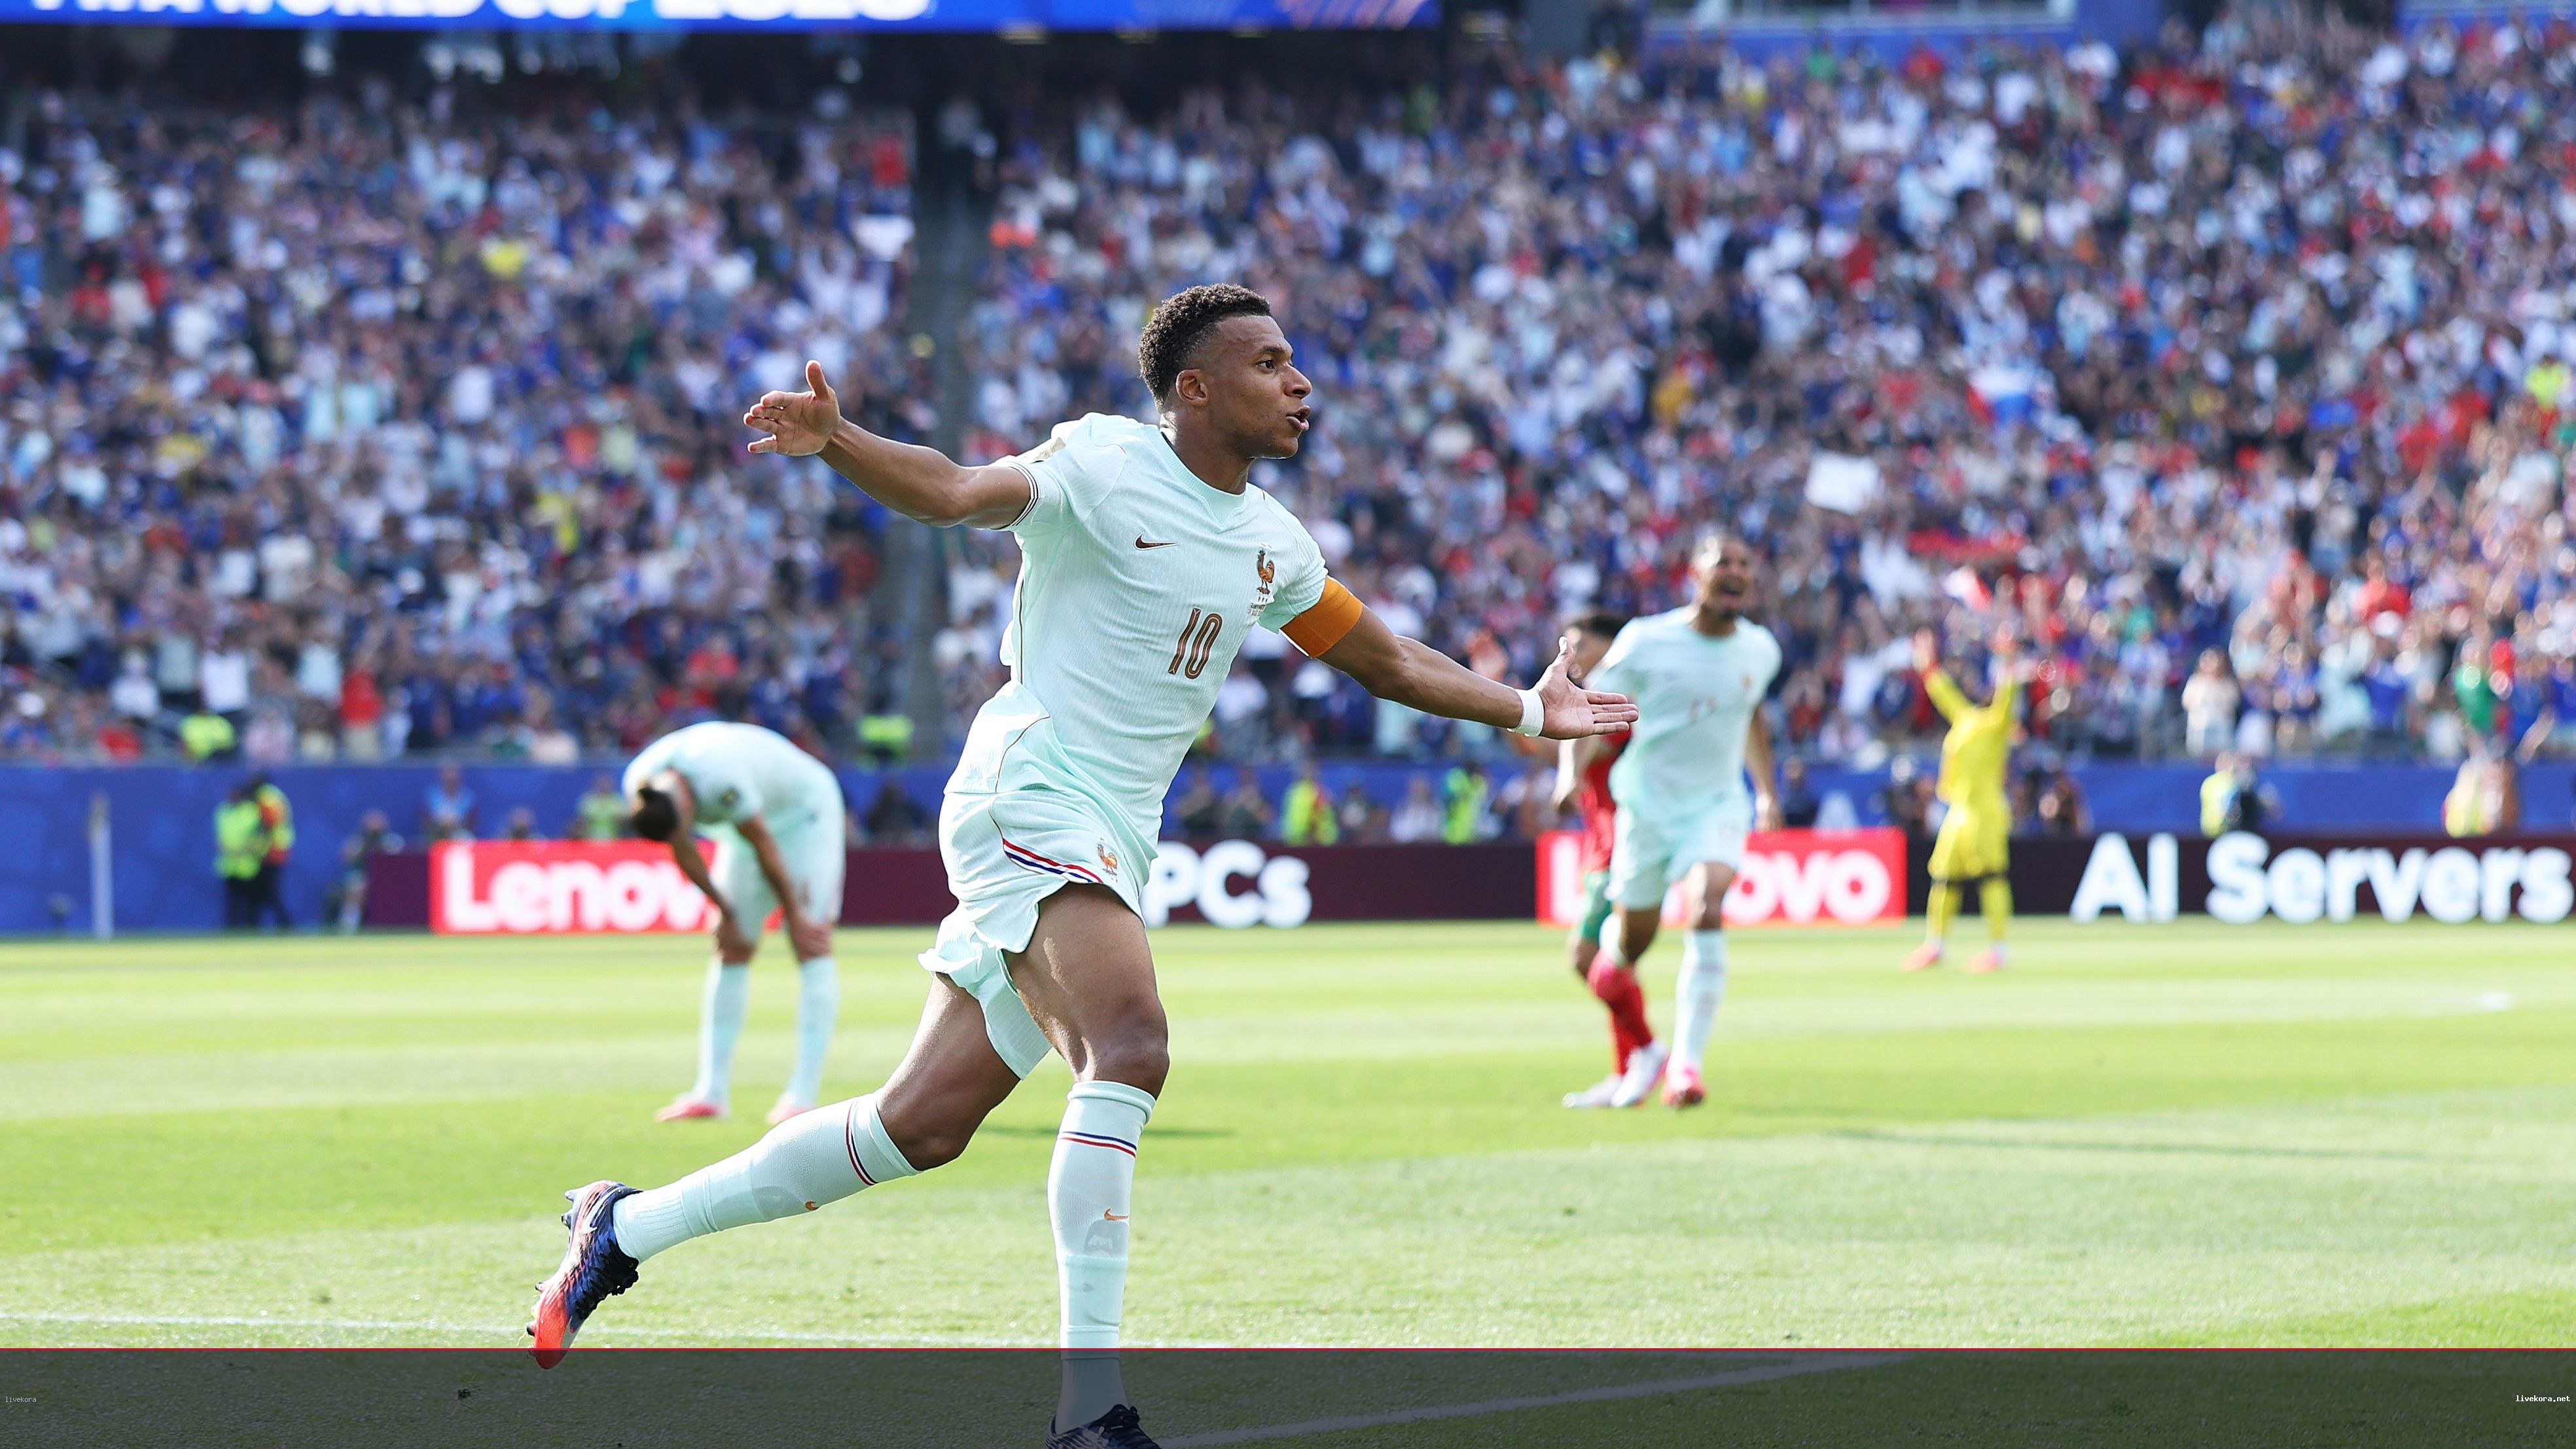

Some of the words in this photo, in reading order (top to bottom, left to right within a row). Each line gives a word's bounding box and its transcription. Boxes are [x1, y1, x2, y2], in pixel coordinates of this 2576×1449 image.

[1168, 607, 1223, 679] 10
[443, 844, 709, 930] Lenov
[1139, 840, 1312, 929] PCs
[1550, 834, 1891, 926] Lovo
[2069, 831, 2179, 924] AI
[2205, 830, 2574, 925] Servers
